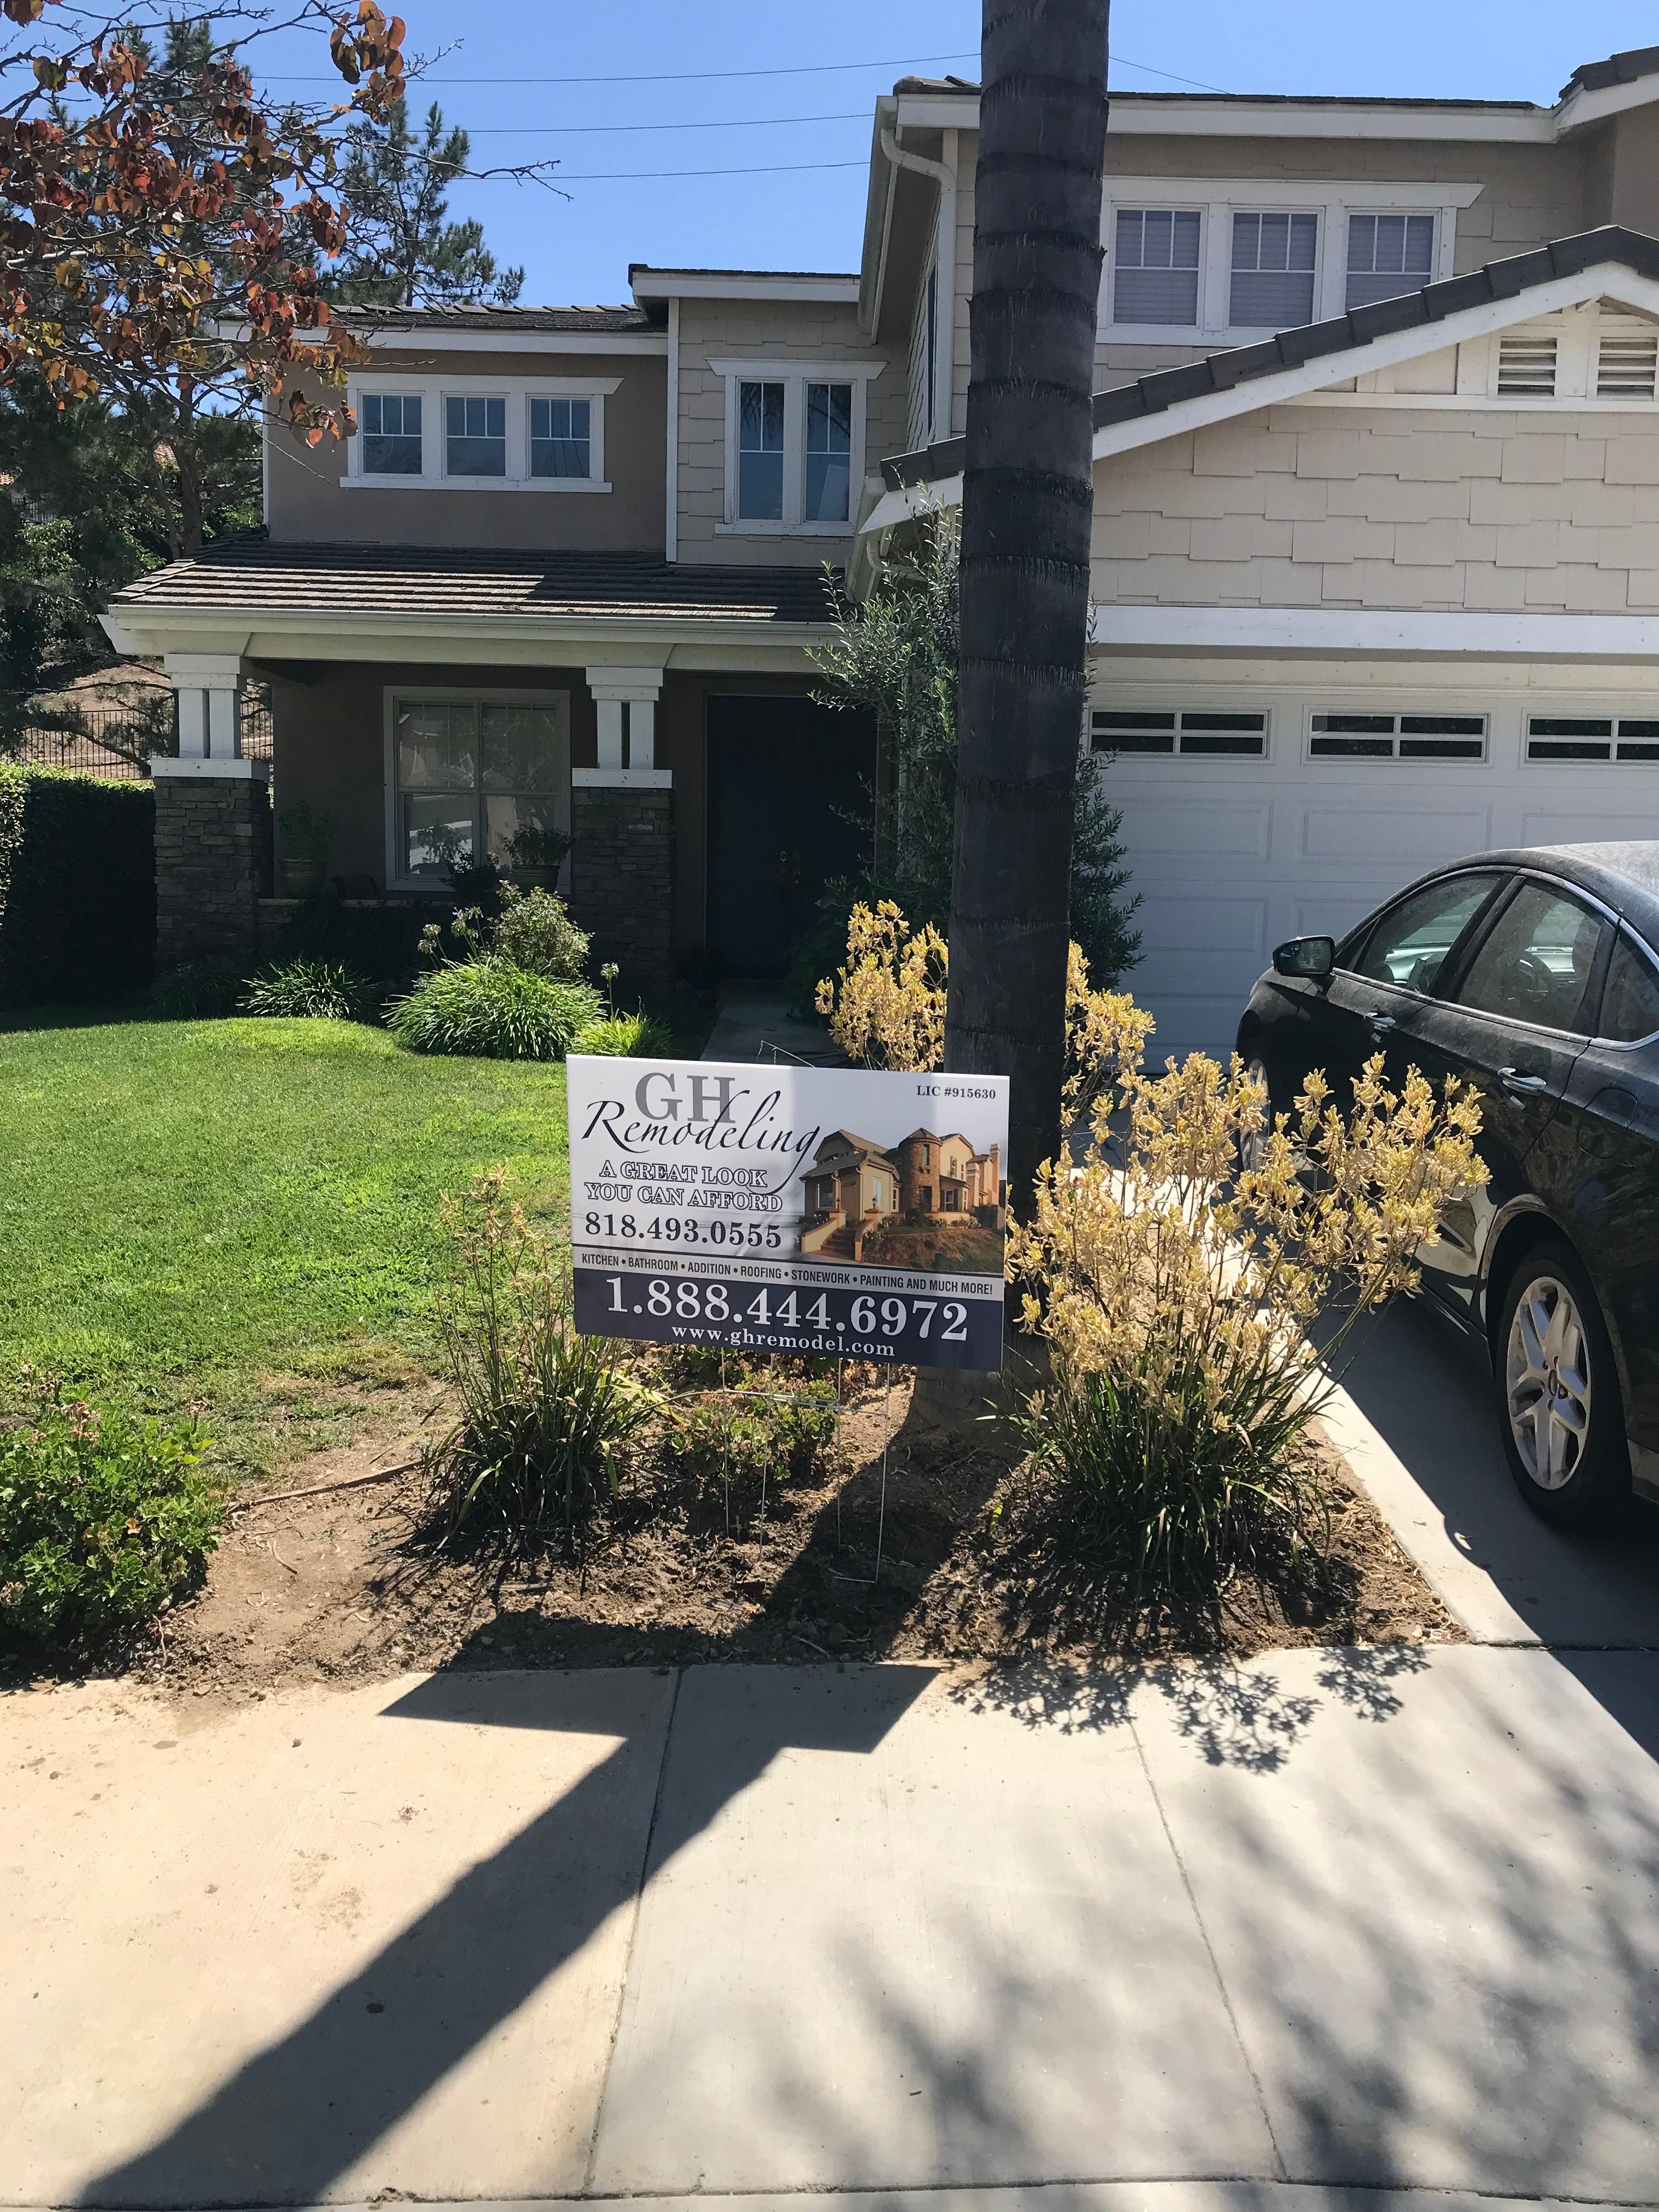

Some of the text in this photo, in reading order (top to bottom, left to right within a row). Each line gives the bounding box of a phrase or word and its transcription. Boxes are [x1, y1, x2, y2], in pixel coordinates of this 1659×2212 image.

[635, 1072, 736, 1124] GH
[916, 1086, 995, 1099] LIC #915630
[581, 1090, 820, 1194] Remodeling
[599, 1160, 768, 1188] A GREAT LOOK
[585, 1183, 783, 1212] YOU CAN AFFORD
[585, 1212, 782, 1248] 818.493.0555
[582, 1254, 993, 1295] KITCHEN BATHROOM ADDITION ROOFING STONEWORK PAINTING AND MUCH MORE!
[606, 1277, 968, 1342] 1.888.444.6972
[671, 1325, 895, 1357] www.ghremodel.com
